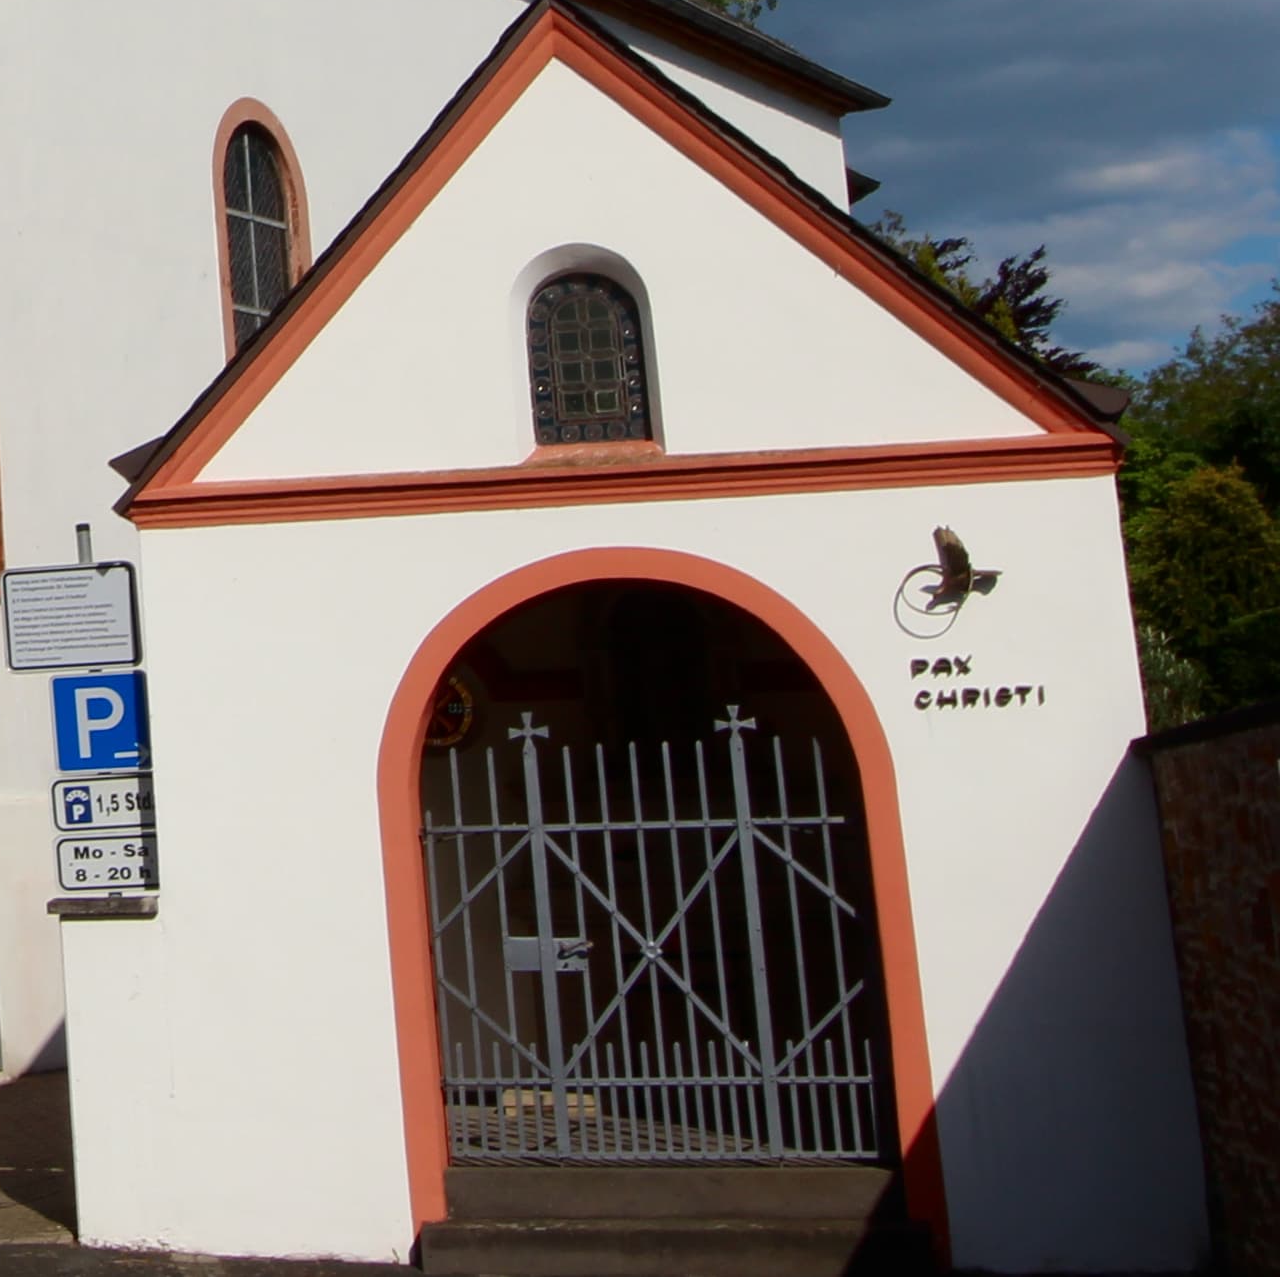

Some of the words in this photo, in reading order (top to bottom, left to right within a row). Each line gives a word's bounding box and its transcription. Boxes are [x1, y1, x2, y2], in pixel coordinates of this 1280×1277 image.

[910, 654, 972, 679] PAX
[913, 685, 1045, 710] CHRISTI
[74, 687, 124, 758] P
[96, 794, 119, 816] 1,5
[73, 846, 103, 860] Mo
[123, 844, 149, 857] Sa
[75, 868, 87, 882] 8
[107, 867, 131, 880] 20
[139, 865, 151, 879] h
